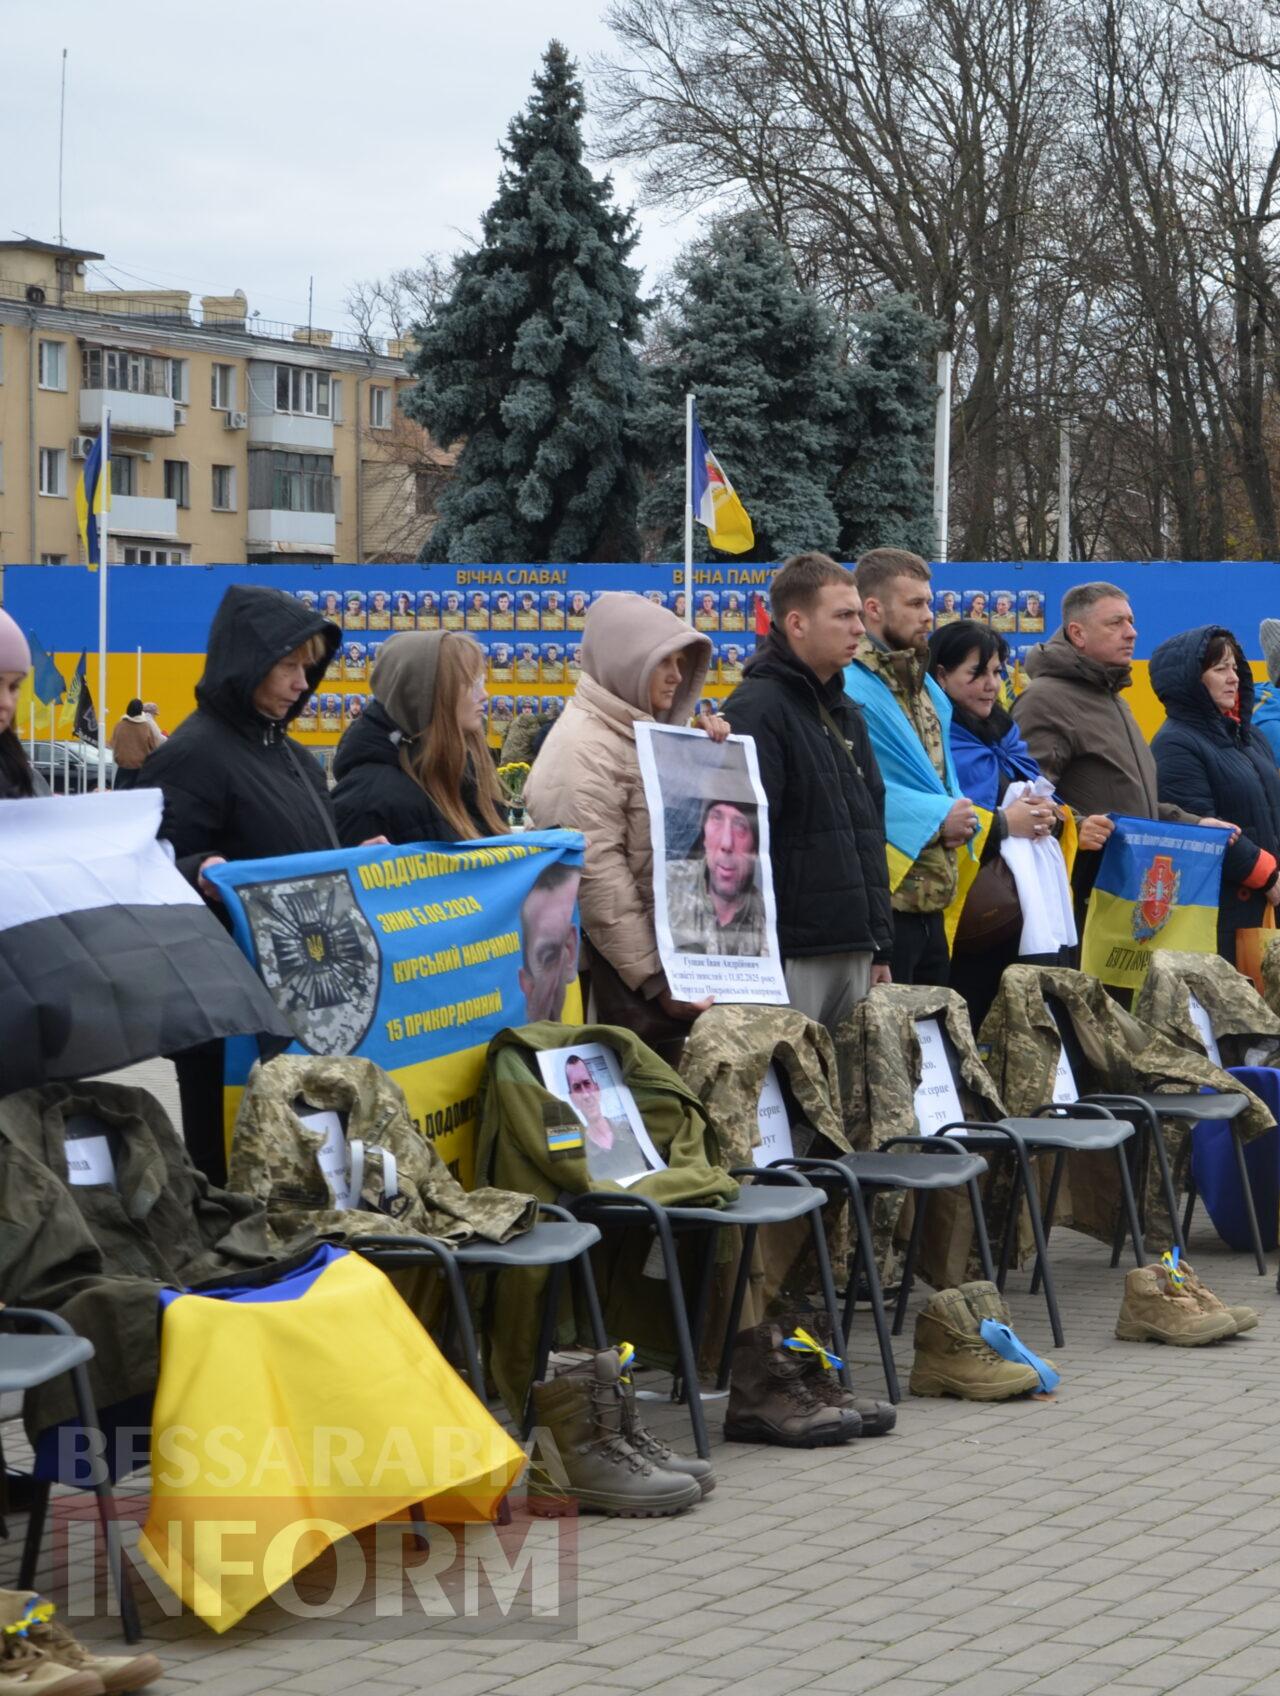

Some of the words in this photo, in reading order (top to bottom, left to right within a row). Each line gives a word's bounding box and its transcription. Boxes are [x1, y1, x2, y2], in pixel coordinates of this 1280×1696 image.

[456, 570, 503, 585] ВІЧНА
[506, 570, 567, 585] СЛАВА!
[672, 569, 724, 584] ВЧНА
[376, 906, 419, 934] ЗНИК
[412, 895, 484, 926] 5.09.2024
[392, 943, 462, 984] КУРСЬКИЙ
[461, 931, 521, 967] НАПРЯМОК
[386, 1018, 403, 1042] 15
[403, 986, 503, 1038] ПРИКОРДОННИЙ
